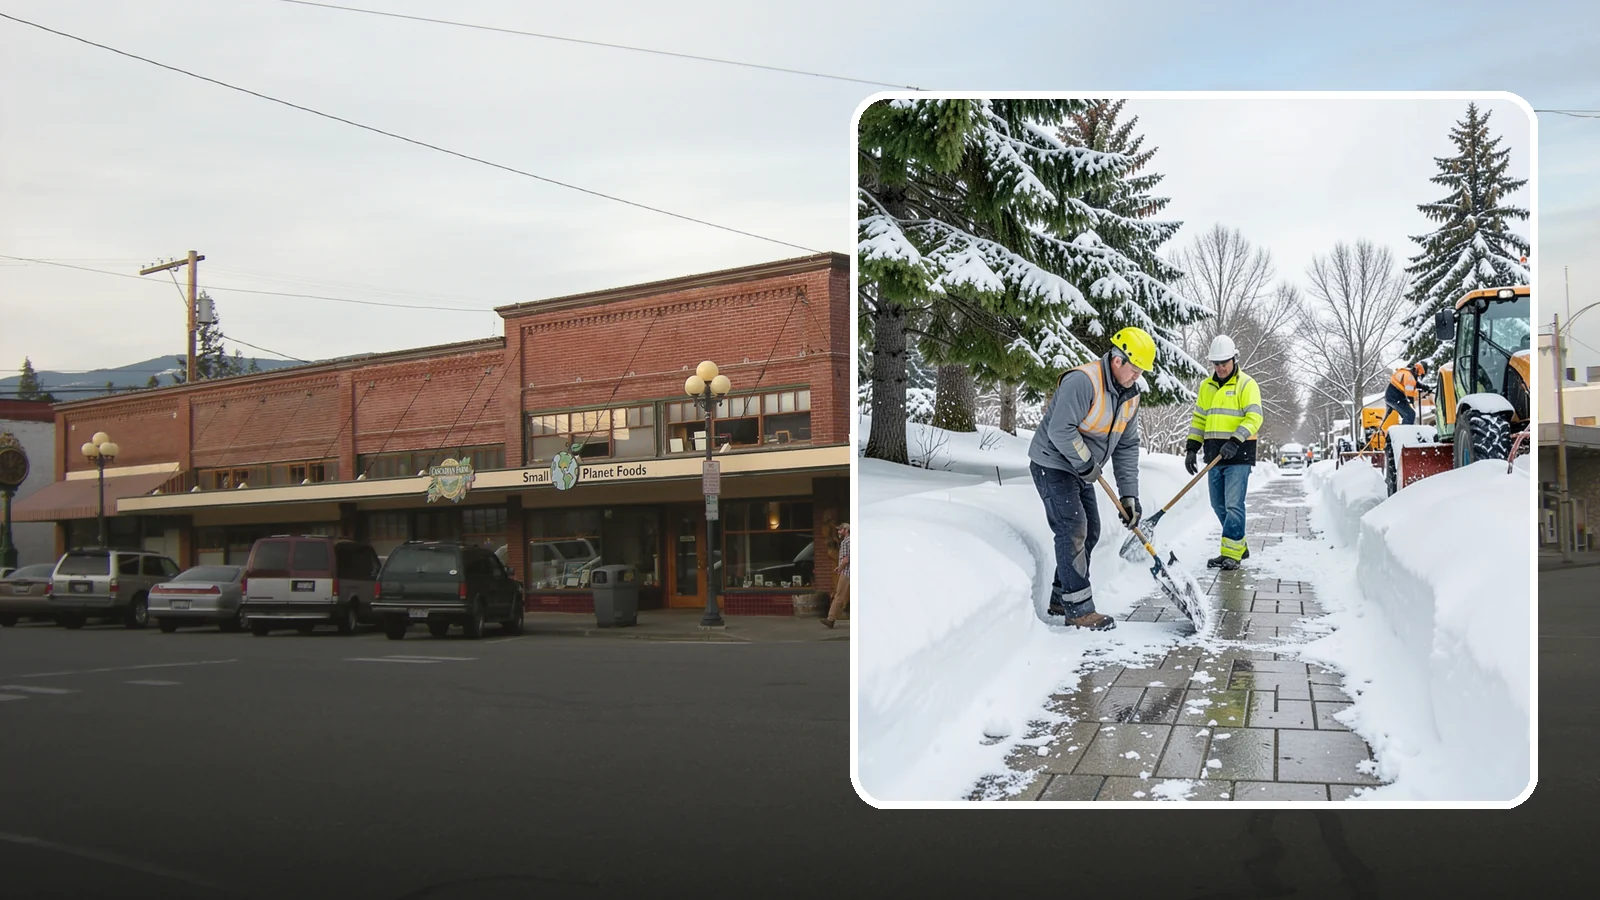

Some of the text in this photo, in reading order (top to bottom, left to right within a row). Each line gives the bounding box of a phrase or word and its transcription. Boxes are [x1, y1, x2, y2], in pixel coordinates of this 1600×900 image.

[523, 464, 647, 483] Small Planet Foods
